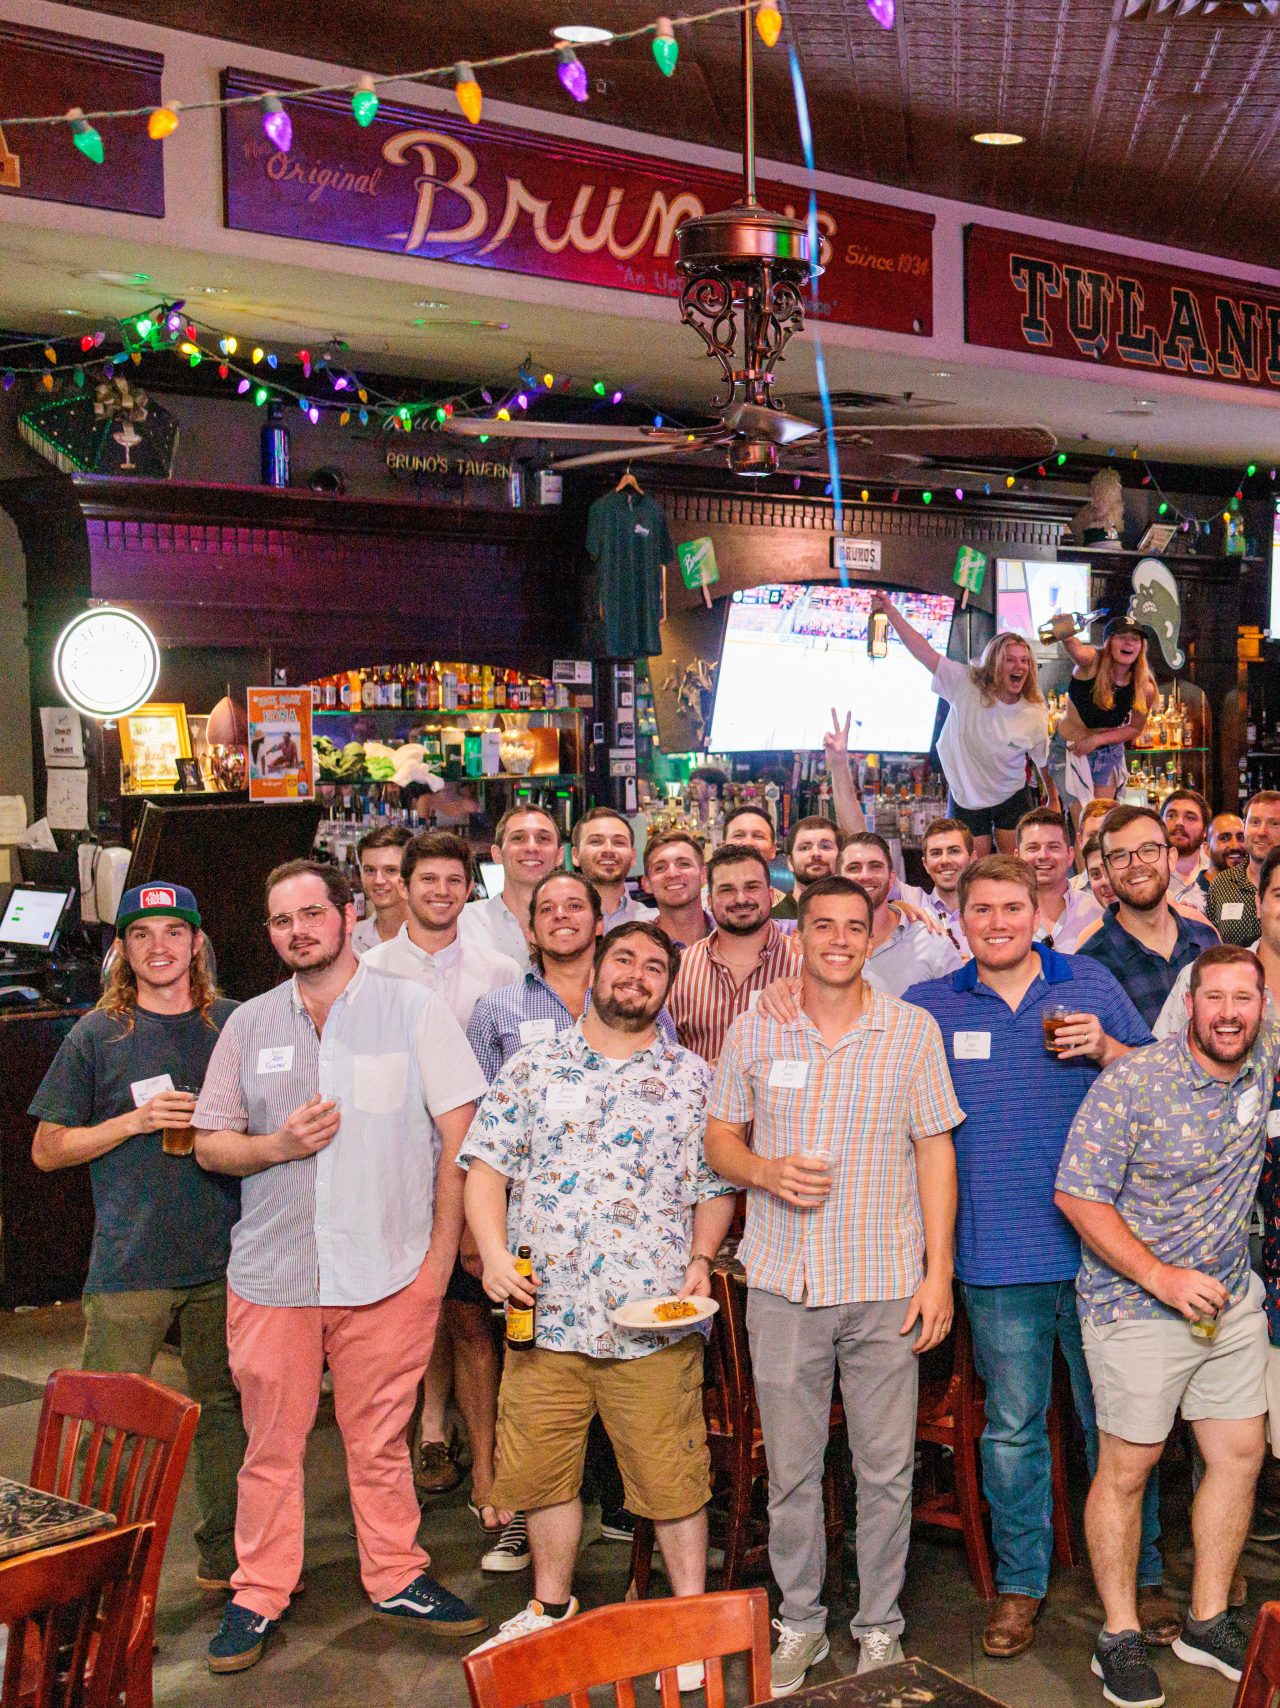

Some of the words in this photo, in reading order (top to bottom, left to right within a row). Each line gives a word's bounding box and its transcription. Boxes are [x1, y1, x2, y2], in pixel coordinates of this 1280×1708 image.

[267, 152, 384, 204] Original
[845, 244, 895, 273] Since
[386, 452, 448, 474] BRUNO'S
[457, 458, 514, 480] TAVERN
